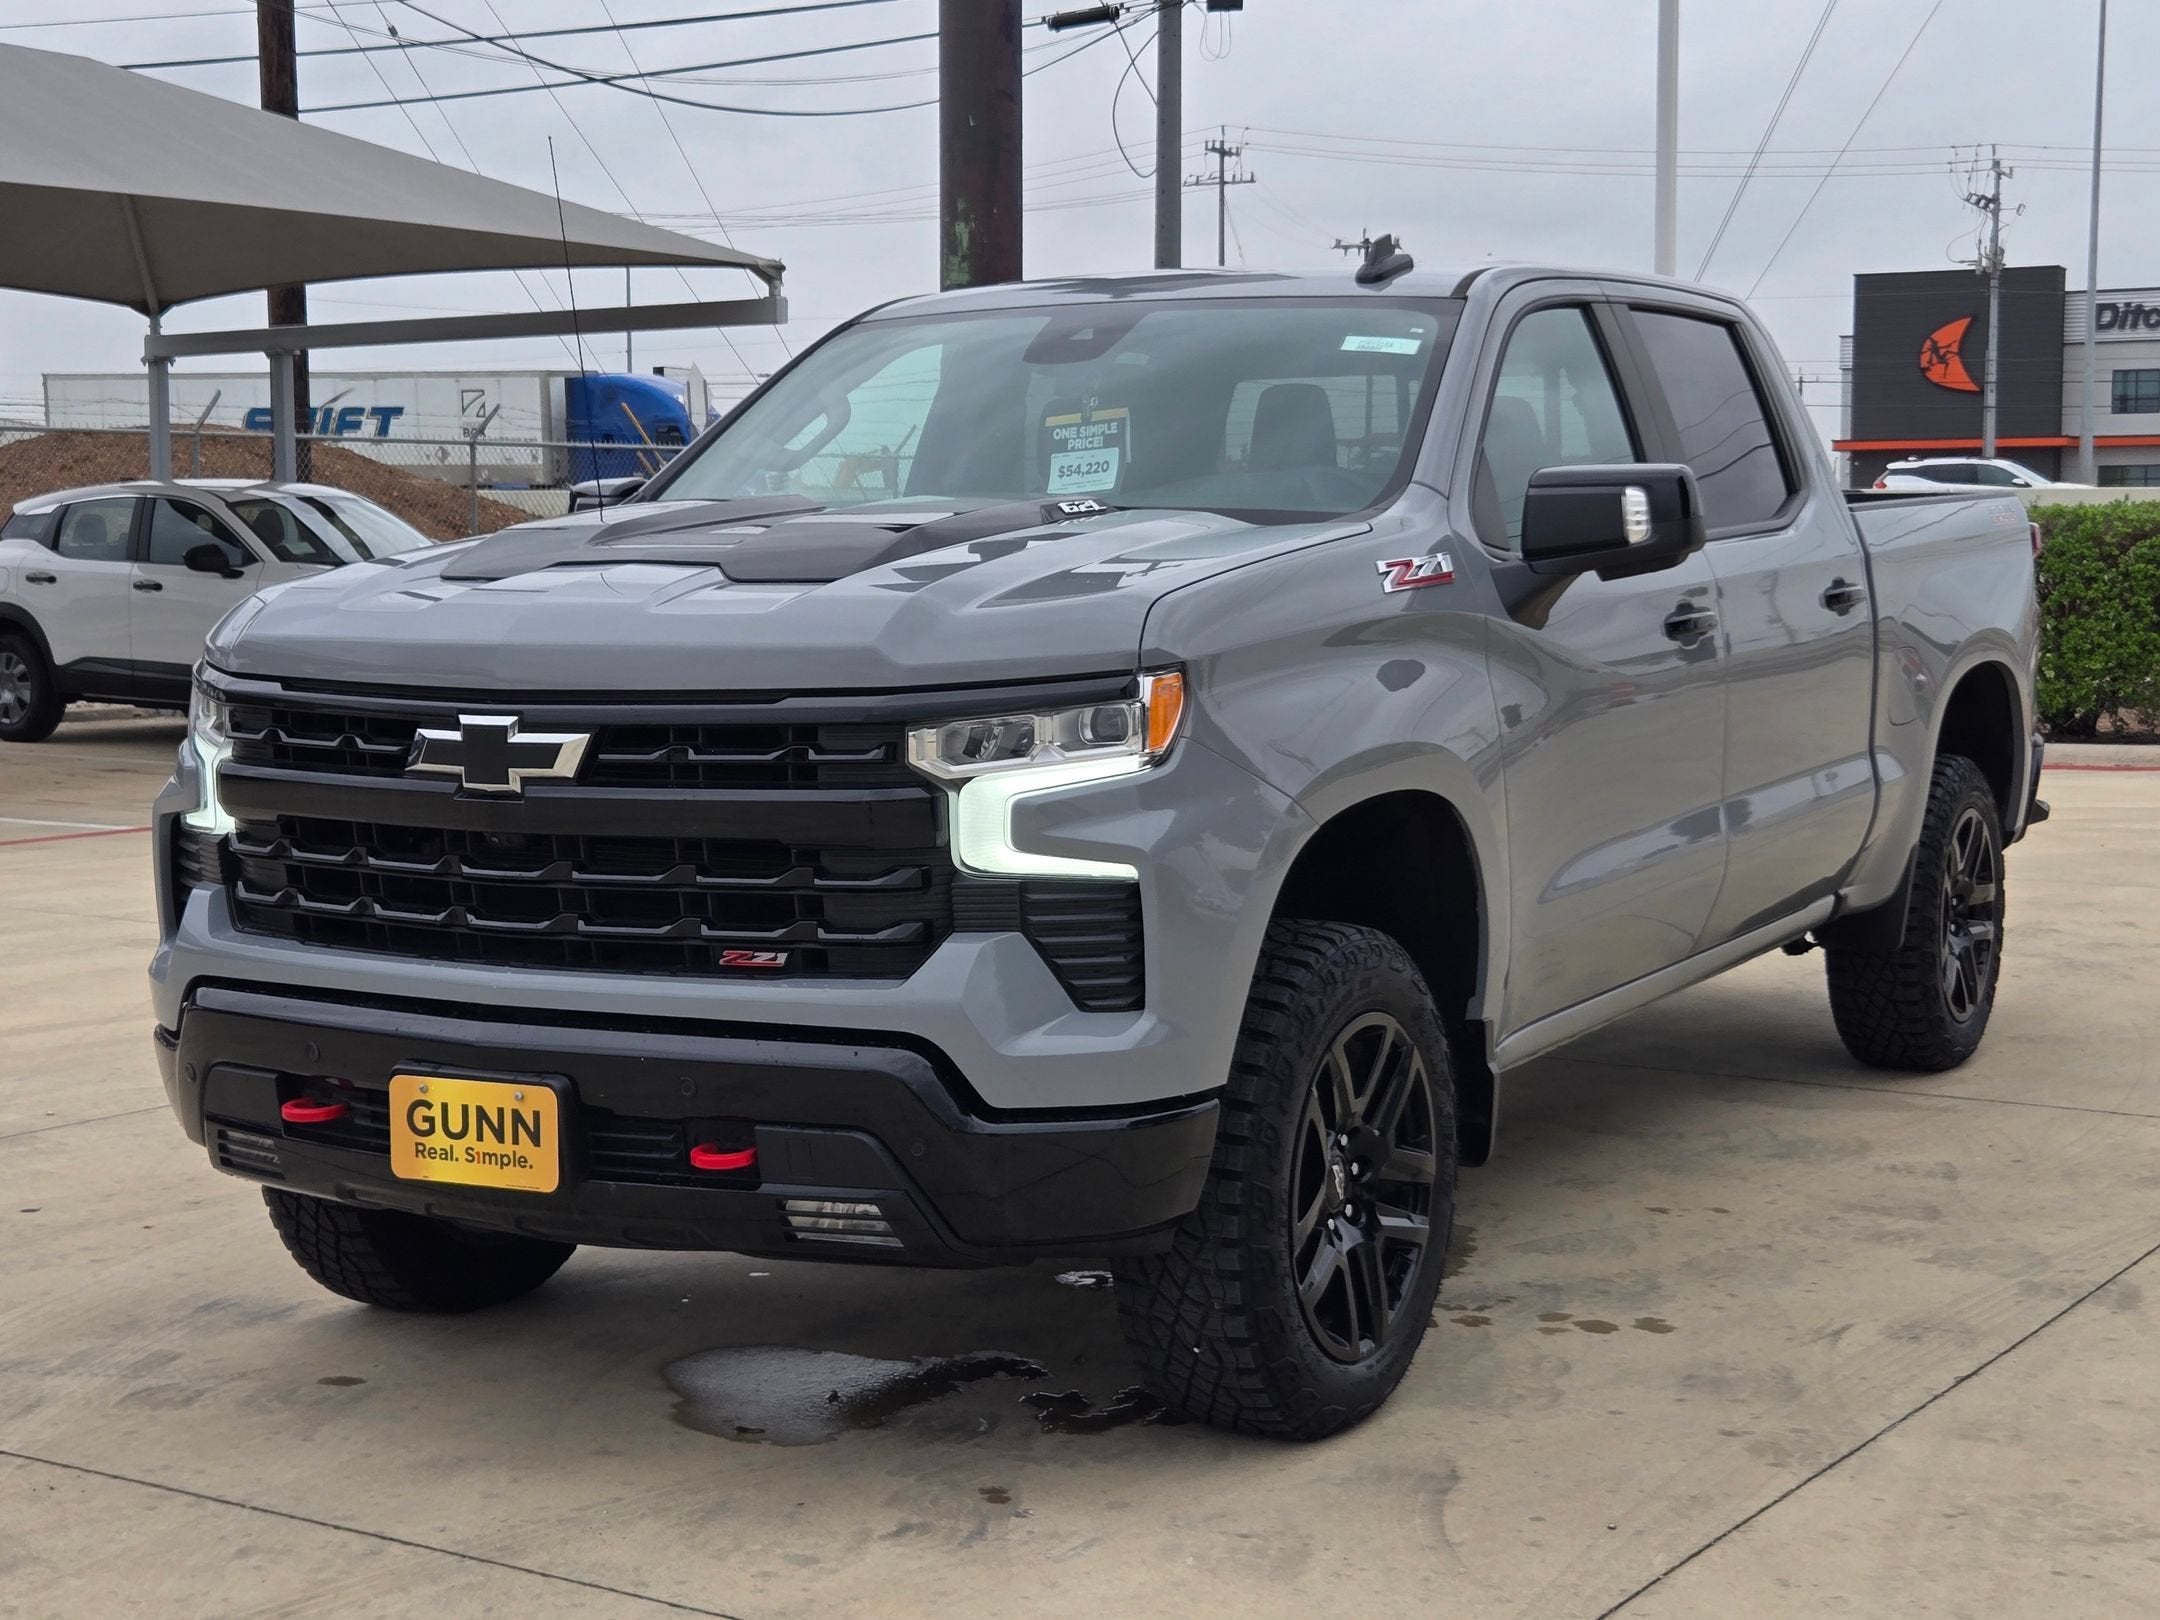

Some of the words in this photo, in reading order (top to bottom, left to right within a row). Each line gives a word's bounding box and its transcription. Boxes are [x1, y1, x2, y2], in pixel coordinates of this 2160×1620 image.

[243, 406, 405, 439] SIFT
[1053, 427, 1078, 440] ONE
[1079, 422, 1118, 437] SIMPLE
[1067, 436, 1104, 451] PRICE!
[1057, 460, 1110, 480] $54,220
[1376, 551, 1455, 594] Z71
[719, 950, 789, 967] Z71
[406, 1099, 541, 1147] GUNN
[414, 1142, 459, 1163] Real.
